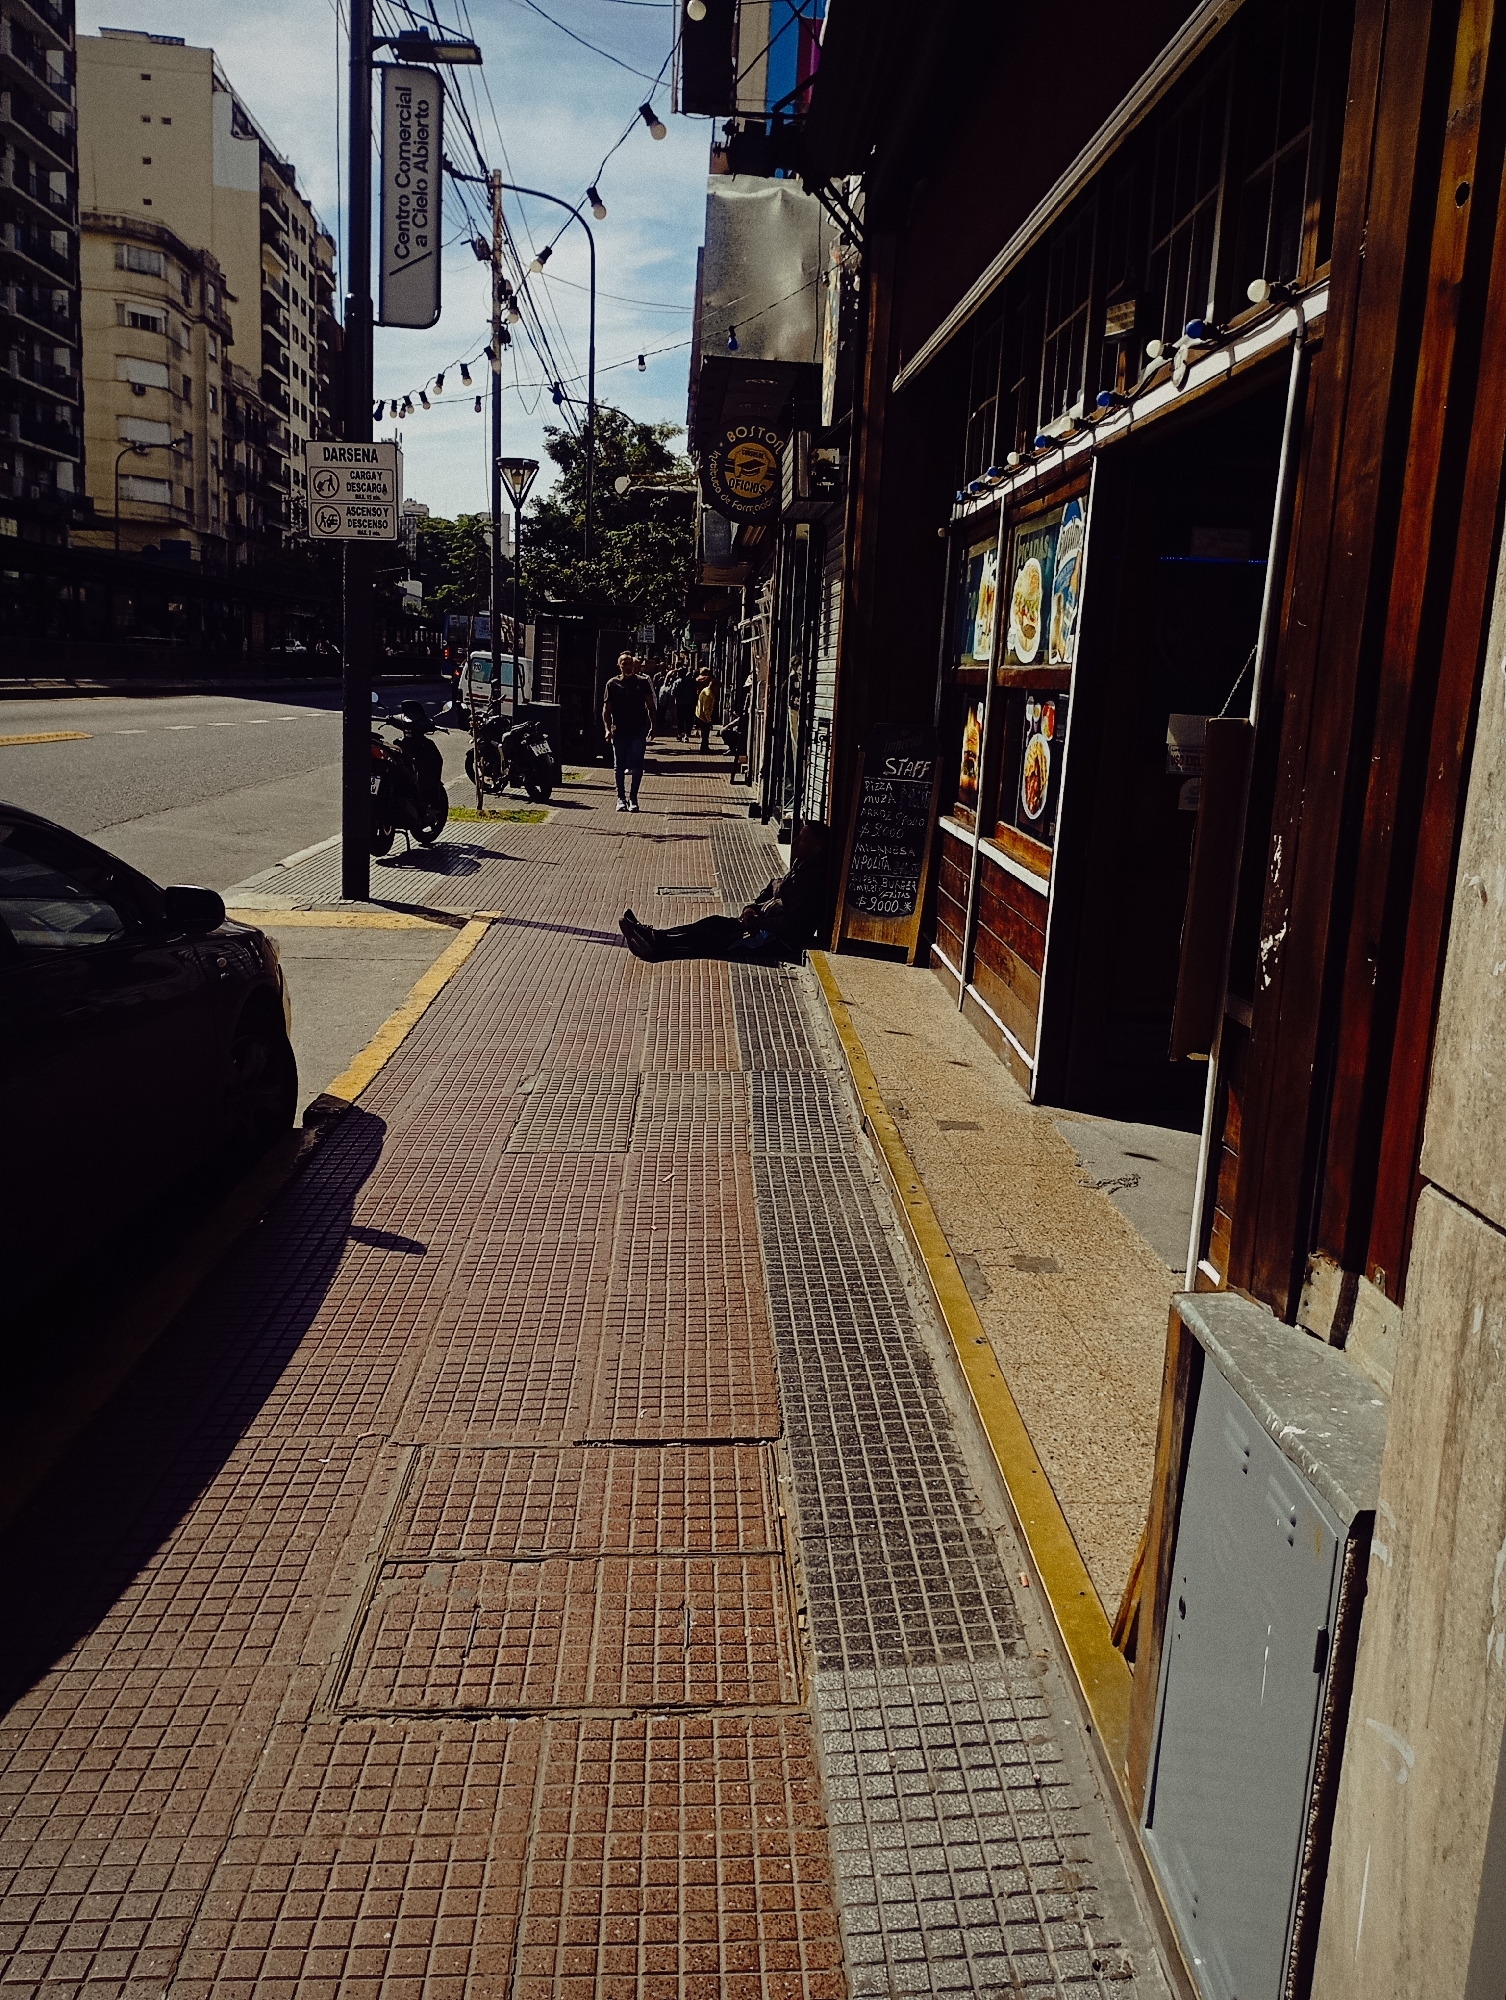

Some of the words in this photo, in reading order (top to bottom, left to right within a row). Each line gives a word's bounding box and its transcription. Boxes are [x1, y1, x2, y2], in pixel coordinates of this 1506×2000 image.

[394, 86, 412, 190] Comercial
[411, 99, 430, 175] Abierto
[411, 178, 429, 230] Cielo
[393, 194, 411, 259] Centro
[415, 234, 429, 249] a
[323, 447, 379, 463] DARSENA
[350, 470, 376, 481] CARGA
[377, 471, 383, 481] Y
[346, 482, 388, 494] DESCARGA
[730, 478, 766, 495] OFICIOS
[346, 506, 381, 518] ASCENSO
[383, 508, 389, 518] Y
[347, 519, 388, 530] DESCENSO
[881, 756, 932, 779] STAFF
[860, 807, 892, 821] ARROZ
[854, 842, 916, 858] MILANESA
[881, 877, 918, 893] BURGER
